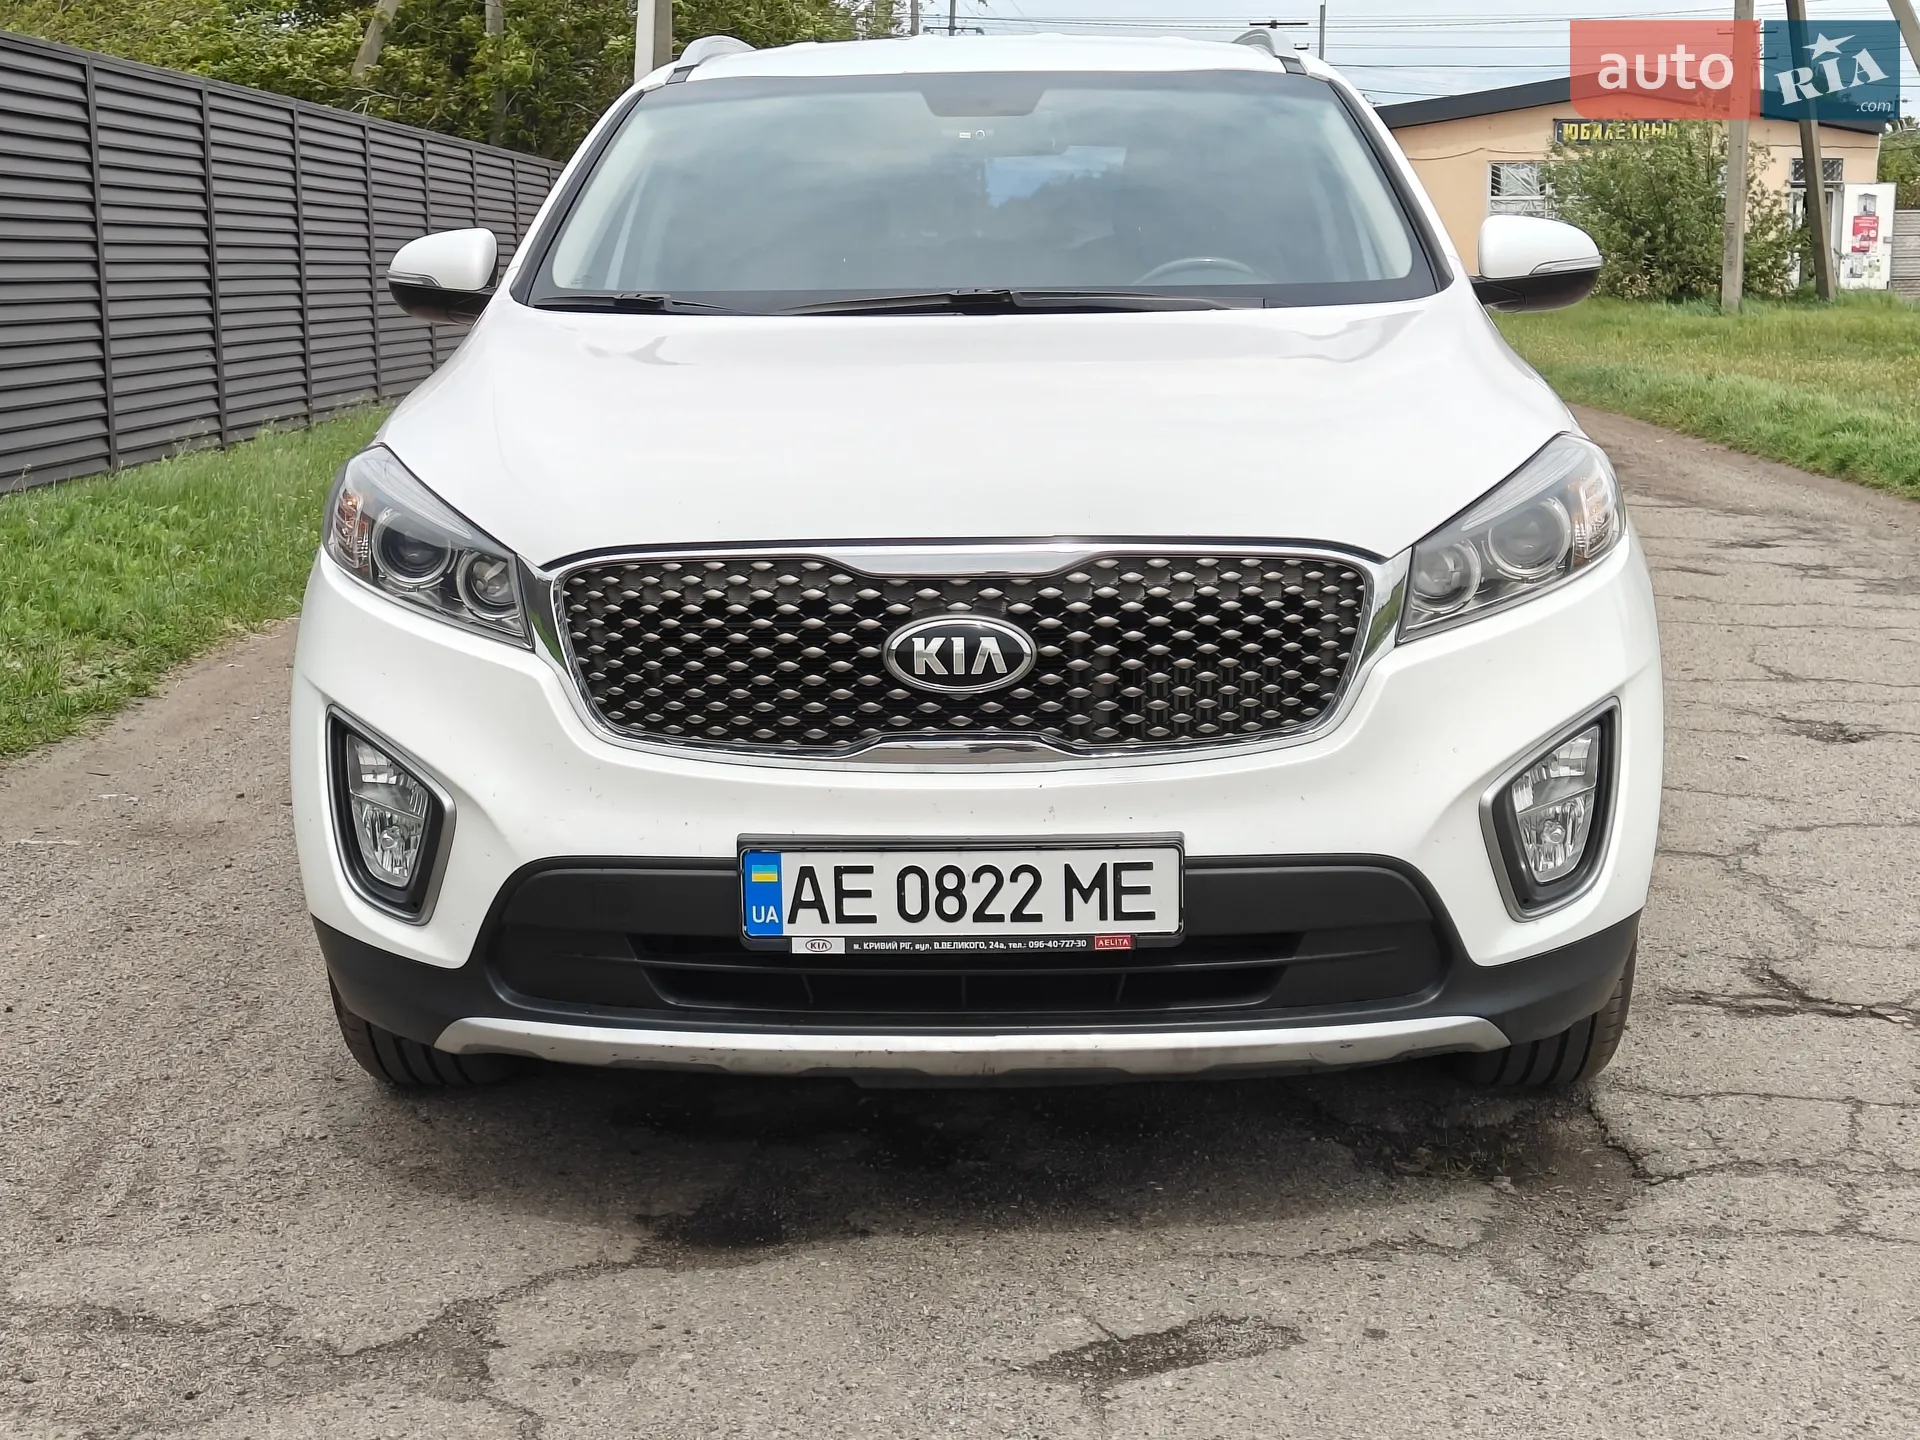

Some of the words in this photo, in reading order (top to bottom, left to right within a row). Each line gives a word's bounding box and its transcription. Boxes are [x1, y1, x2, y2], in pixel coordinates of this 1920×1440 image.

[911, 637, 1008, 675] KIA
[787, 865, 878, 925] AE
[896, 863, 1044, 924] 0822
[1064, 861, 1157, 923] ME
[752, 905, 780, 924] UA
[863, 940, 898, 950] КРИВИЙ
[1028, 940, 1087, 949] 096-40-727-30
[1098, 938, 1130, 947] AELITA
